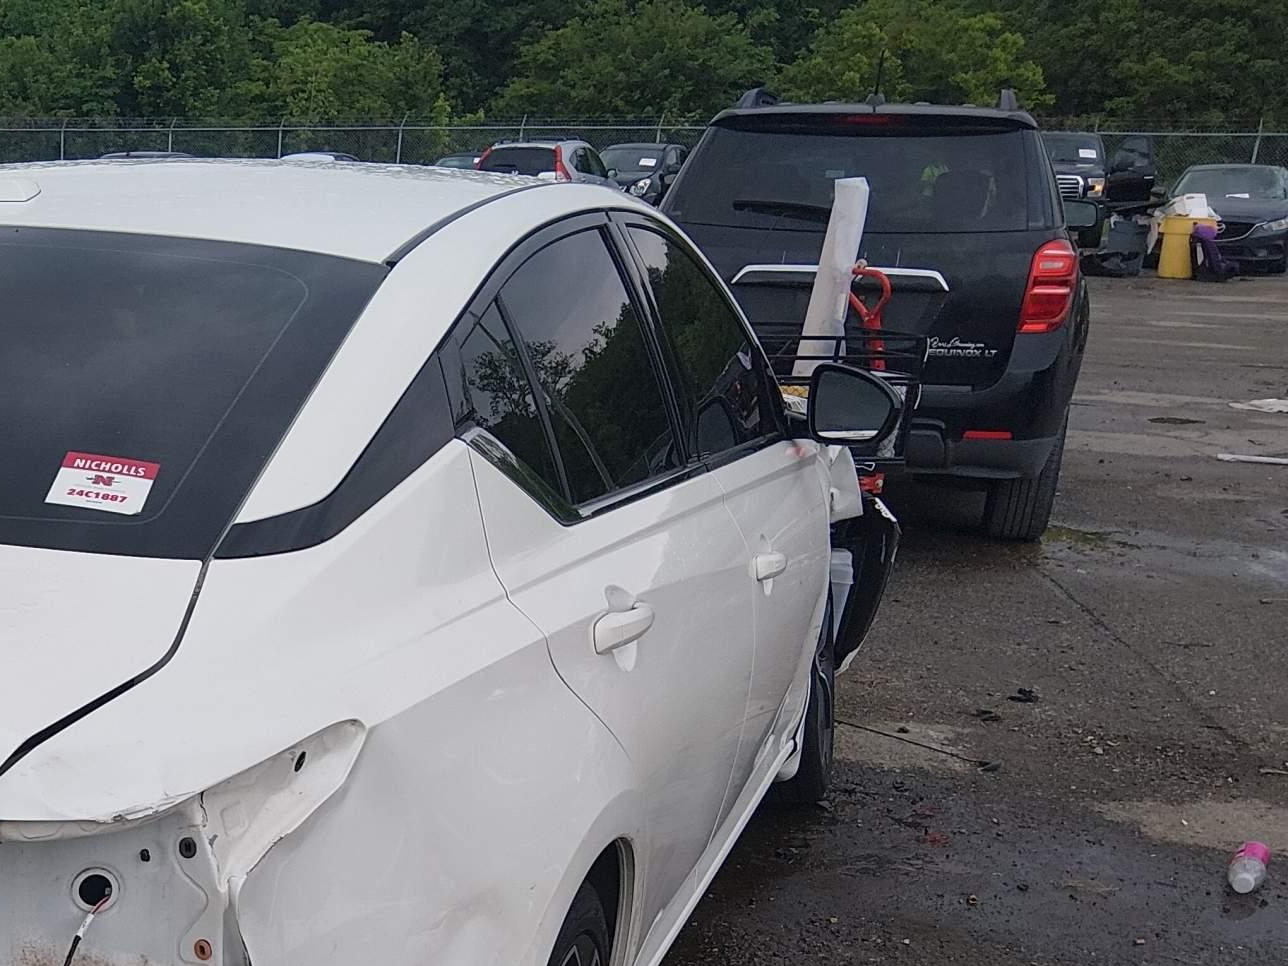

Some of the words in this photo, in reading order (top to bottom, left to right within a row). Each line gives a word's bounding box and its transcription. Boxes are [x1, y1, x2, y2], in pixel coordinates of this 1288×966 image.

[928, 348, 982, 357] EQUINOX
[984, 349, 998, 357] LT
[73, 458, 146, 476] NICHOLLS
[66, 488, 128, 503] 24C1887
